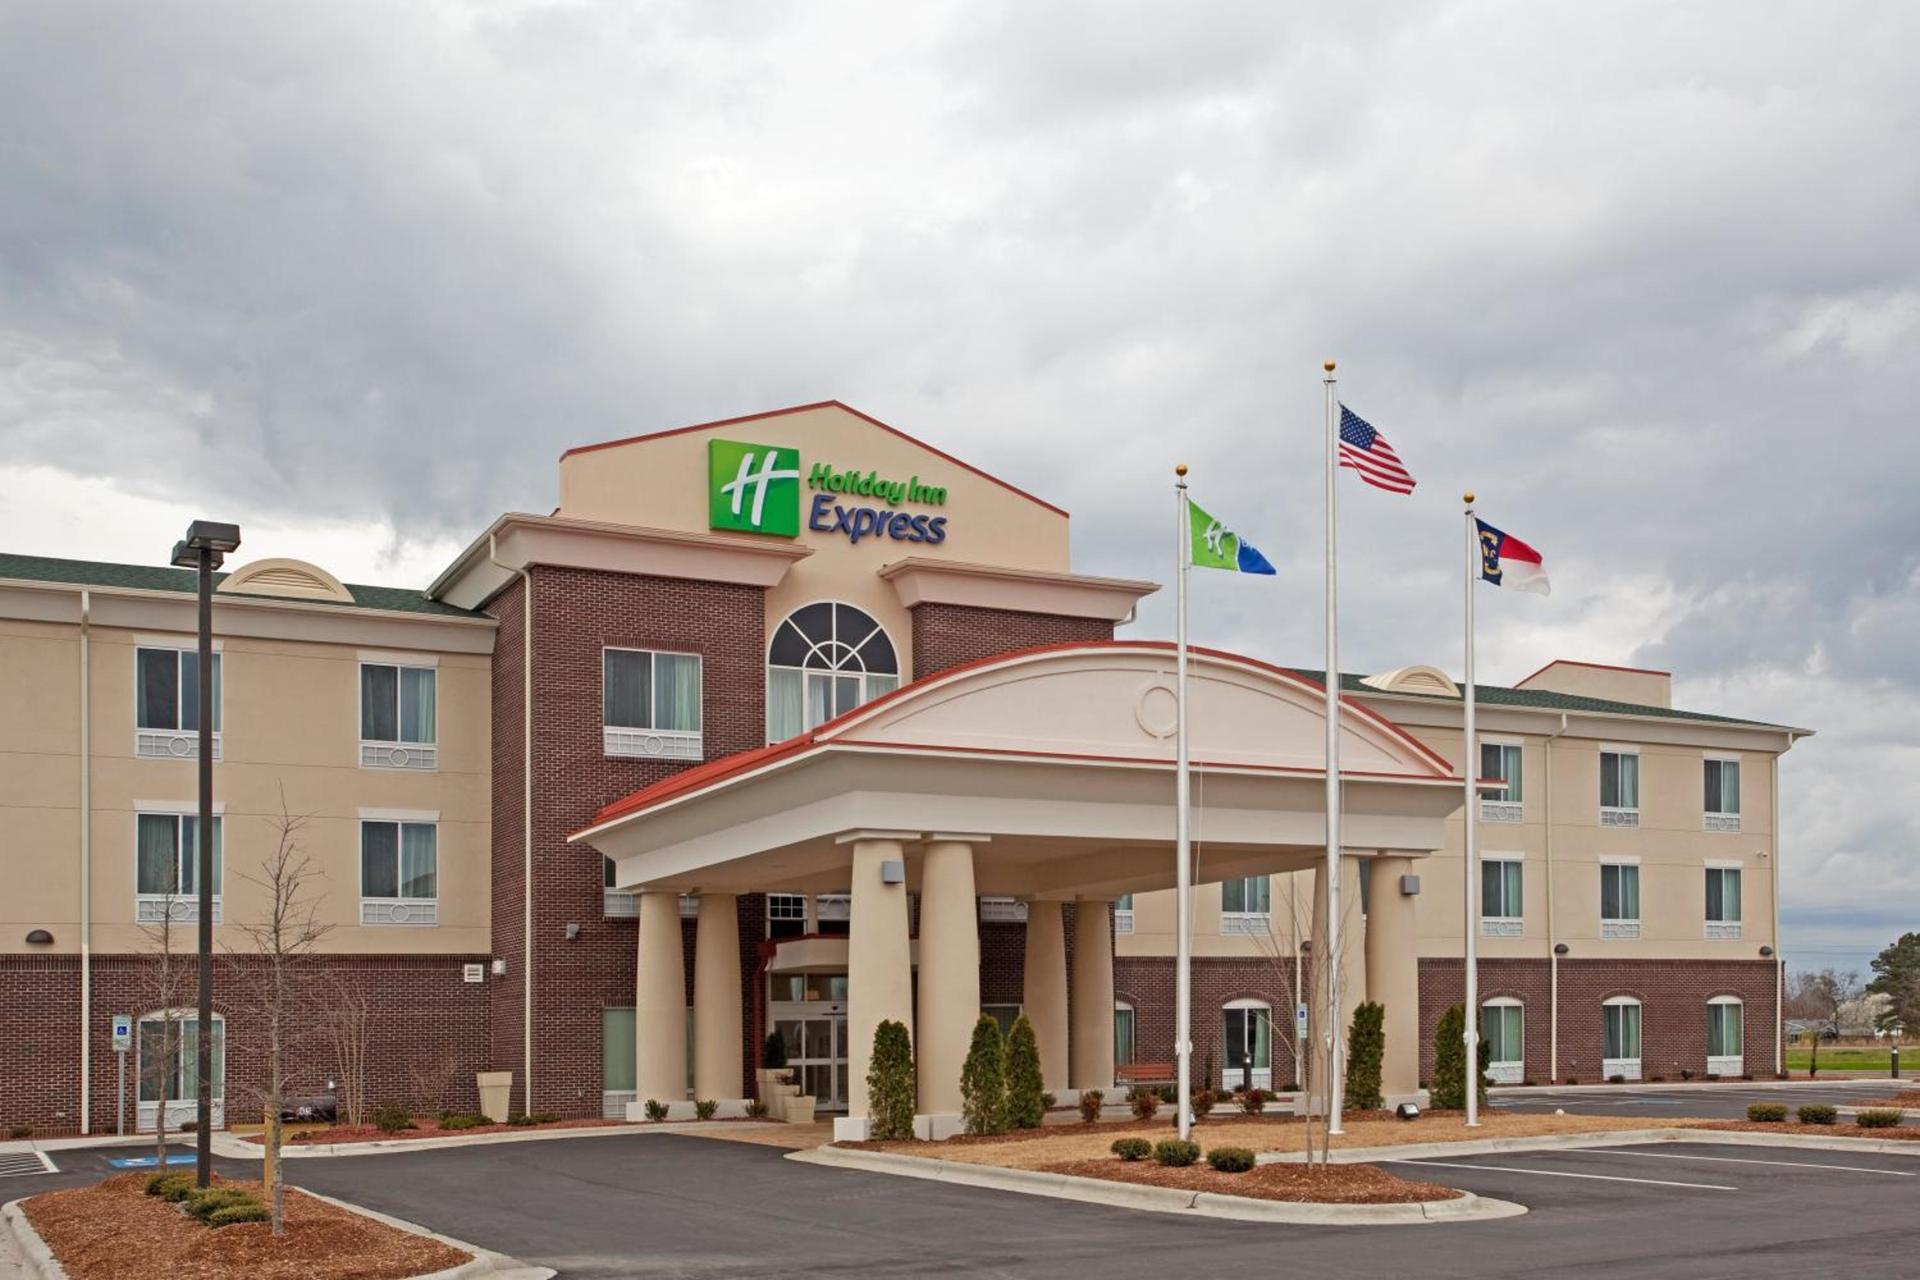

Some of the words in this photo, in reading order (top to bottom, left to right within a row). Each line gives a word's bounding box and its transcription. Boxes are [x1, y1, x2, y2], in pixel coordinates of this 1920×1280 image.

[808, 463, 906, 505] Holiday
[909, 476, 947, 505] Inn
[809, 494, 947, 544] Express
